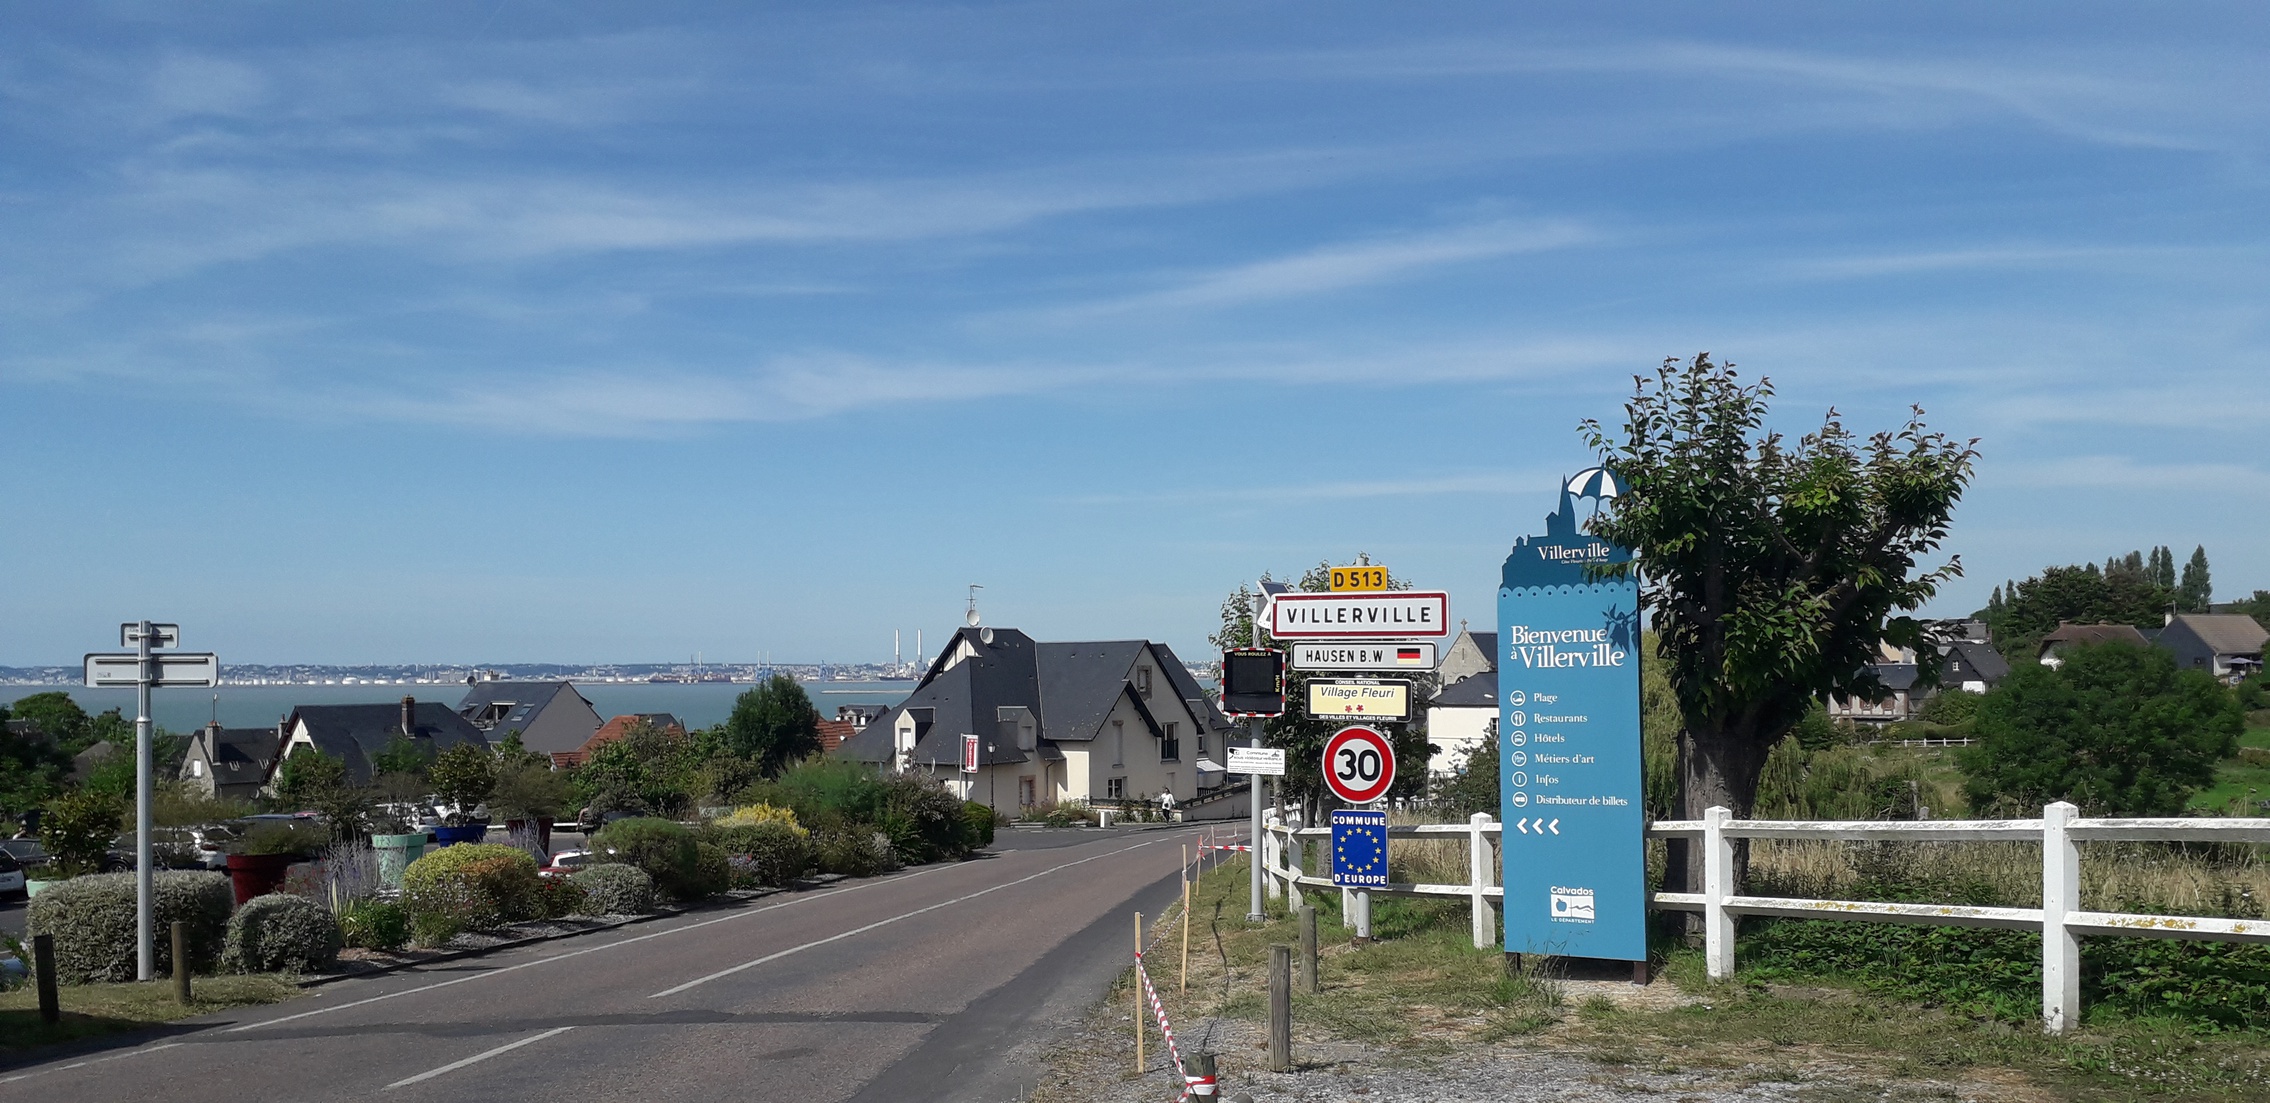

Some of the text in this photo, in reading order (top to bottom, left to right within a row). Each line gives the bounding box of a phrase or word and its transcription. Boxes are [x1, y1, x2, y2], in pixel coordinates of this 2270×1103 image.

[1537, 543, 1610, 560] Villerville
[1334, 571, 1383, 588] D 513
[1286, 606, 1432, 624] VILLERVILLE
[1511, 625, 1607, 645] Bienvenue
[1305, 649, 1383, 663] HAUSEN B.W
[1511, 644, 1625, 669] à Villerville
[1321, 687, 1395, 699] Village Fleuri
[1533, 692, 1558, 704] Plage
[1534, 713, 1588, 723] Restaurants
[1534, 733, 1565, 744] Hôtels
[1534, 753, 1595, 764] Métiers d'art
[1337, 749, 1382, 781] 30
[1535, 774, 1559, 785] Infos
[1536, 795, 1628, 807] Distributeur de billets
[1332, 815, 1386, 826] COMMUNE
[1334, 873, 1387, 885] D'EUROPE
[1551, 886, 1593, 895] Calvados
